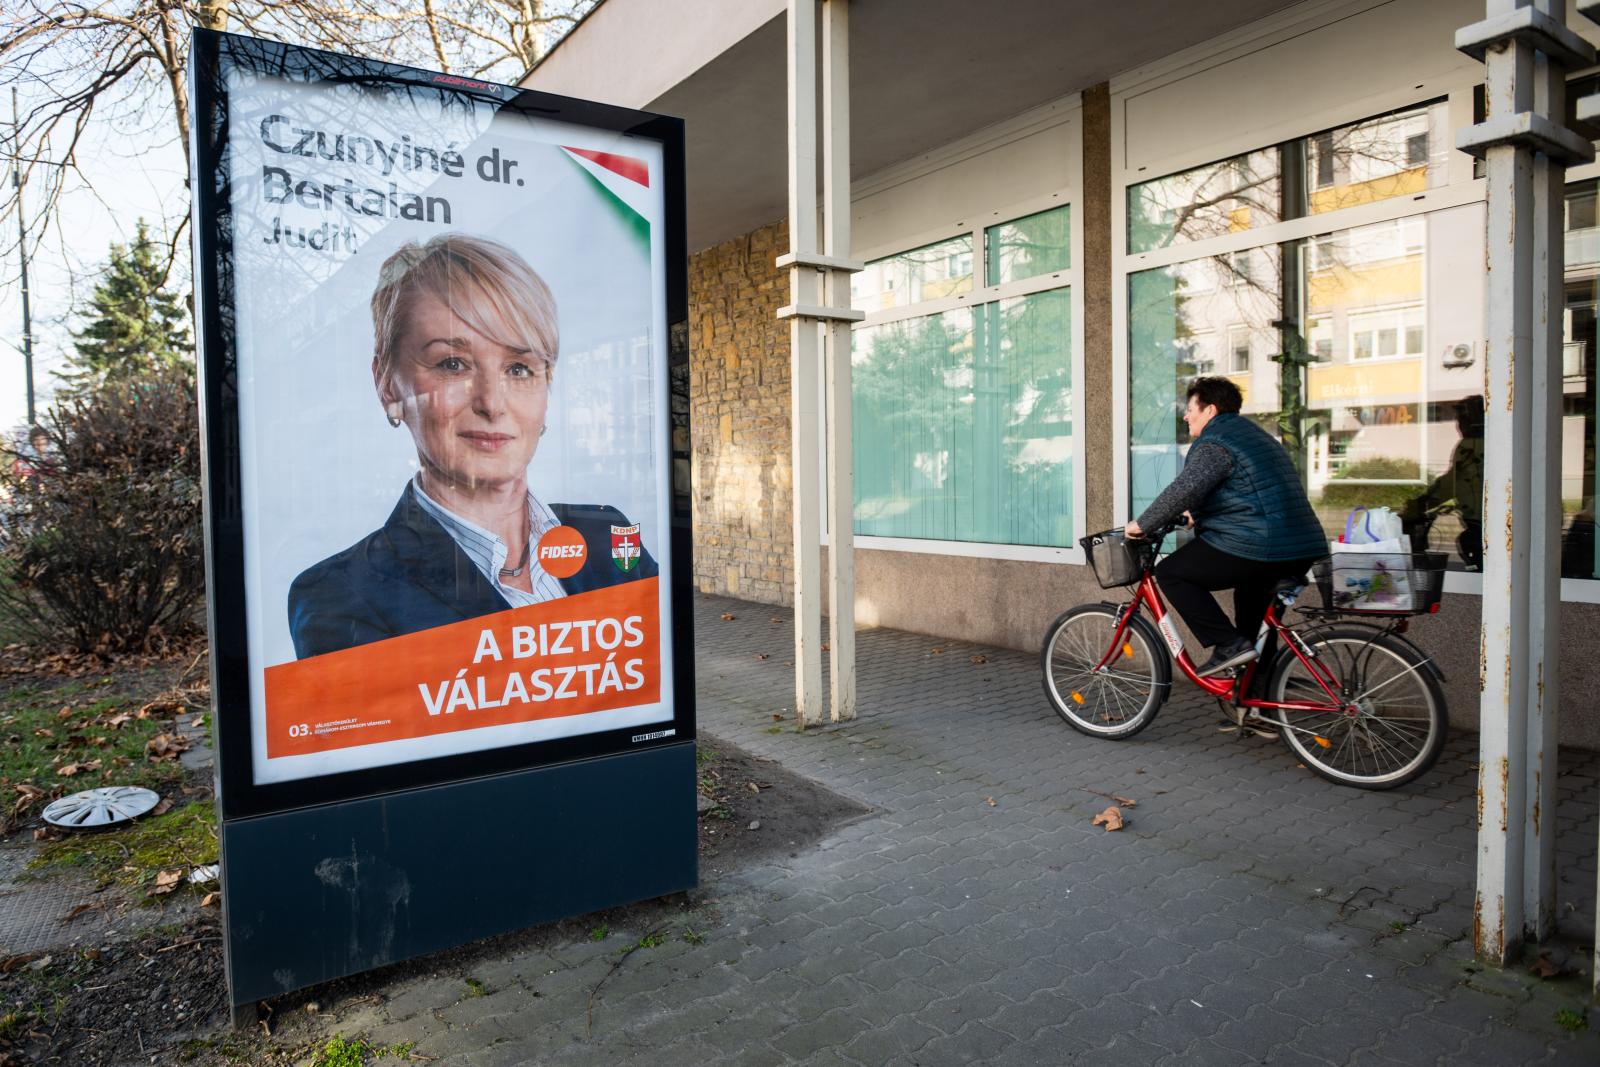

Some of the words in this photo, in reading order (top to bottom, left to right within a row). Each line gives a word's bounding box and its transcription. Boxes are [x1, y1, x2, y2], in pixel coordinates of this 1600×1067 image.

[260, 114, 465, 176] Czunyiné
[476, 147, 525, 187] dr.
[262, 165, 452, 225] Bertalan
[263, 217, 358, 254] Judit
[540, 544, 584, 560] FIDESZ
[473, 629, 502, 664] A
[512, 615, 644, 660] BIZTOS
[418, 652, 645, 716] VÁLASZTÁS
[288, 723, 313, 738] 03.
